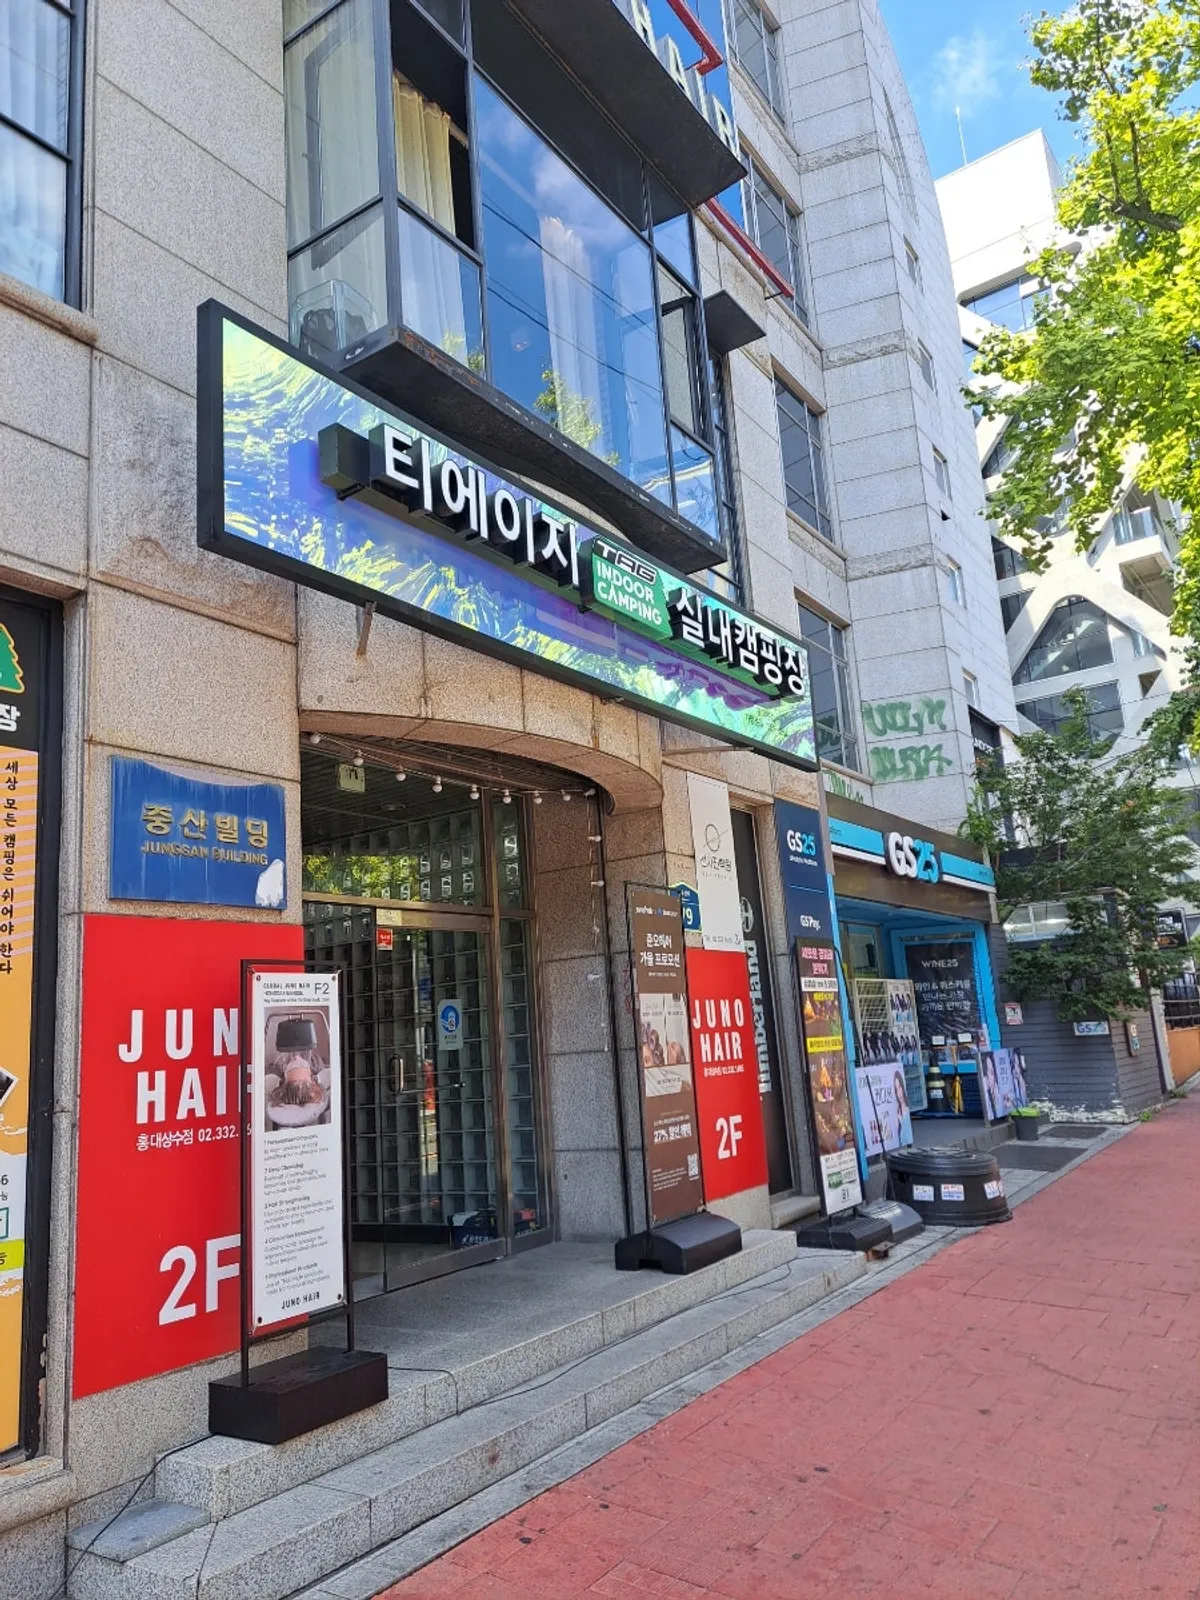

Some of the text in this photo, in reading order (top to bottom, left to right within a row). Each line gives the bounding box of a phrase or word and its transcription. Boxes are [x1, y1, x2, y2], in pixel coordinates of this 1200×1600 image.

[384, 426, 579, 585] 티에이지
[596, 540, 657, 585] TAG
[596, 560, 655, 604] INDOOR
[597, 581, 663, 626] CAMPING
[676, 587, 806, 696] 실내캠핑장
[141, 803, 269, 849] 중산빌딩
[786, 829, 816, 856] GS25
[0, 760, 19, 975] 세상 모든 캠핑은 쉬어야 한다
[141, 840, 269, 866] JUNGSAN BUILDING
[886, 832, 939, 884] GS25
[655, 953, 681, 968] 프로모션
[921, 959, 960, 969] WINE25
[314, 982, 330, 994] F2
[118, 1007, 240, 1063] JUN
[692, 998, 745, 1029] JUNO
[700, 1031, 743, 1063] HAIR
[136, 1128, 194, 1152] 홍대상수점
[714, 1115, 743, 1161] 2F
[158, 1234, 241, 1326] 2F
[281, 1291, 320, 1310] JUNO HAIR
